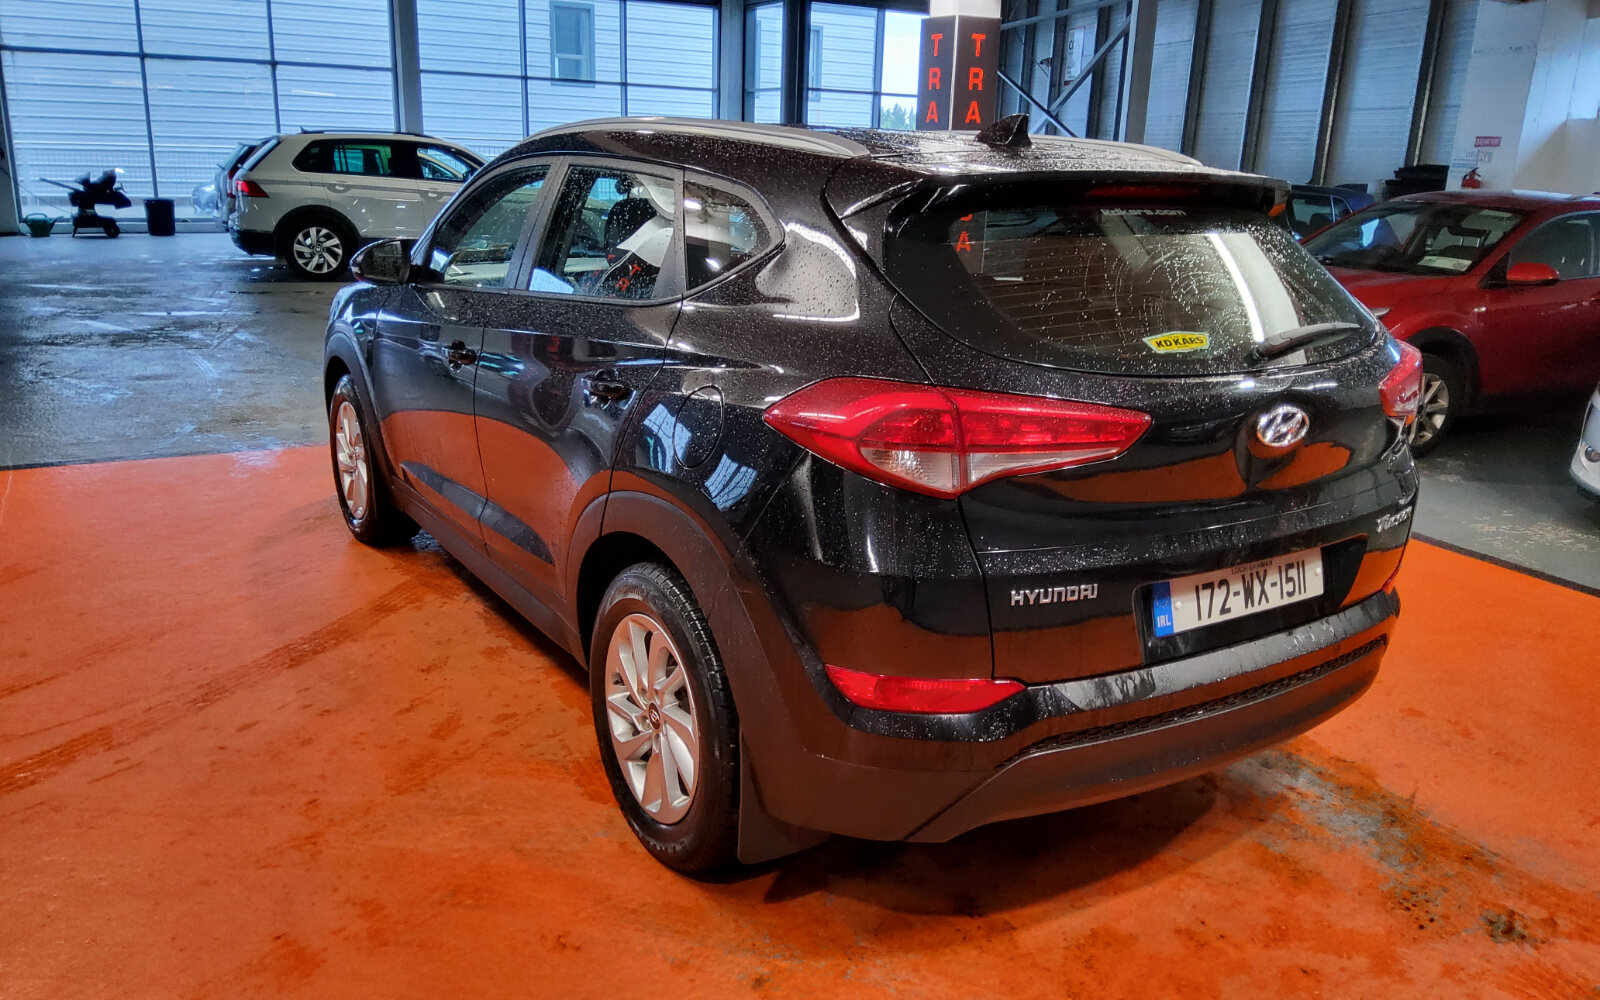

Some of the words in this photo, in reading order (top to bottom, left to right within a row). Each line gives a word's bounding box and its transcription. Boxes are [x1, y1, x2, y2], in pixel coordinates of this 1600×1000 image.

[1011, 583, 1098, 606] HYUNDAI
[1195, 560, 1307, 622] 172-WX-1511
[1157, 614, 1172, 628] IRL
